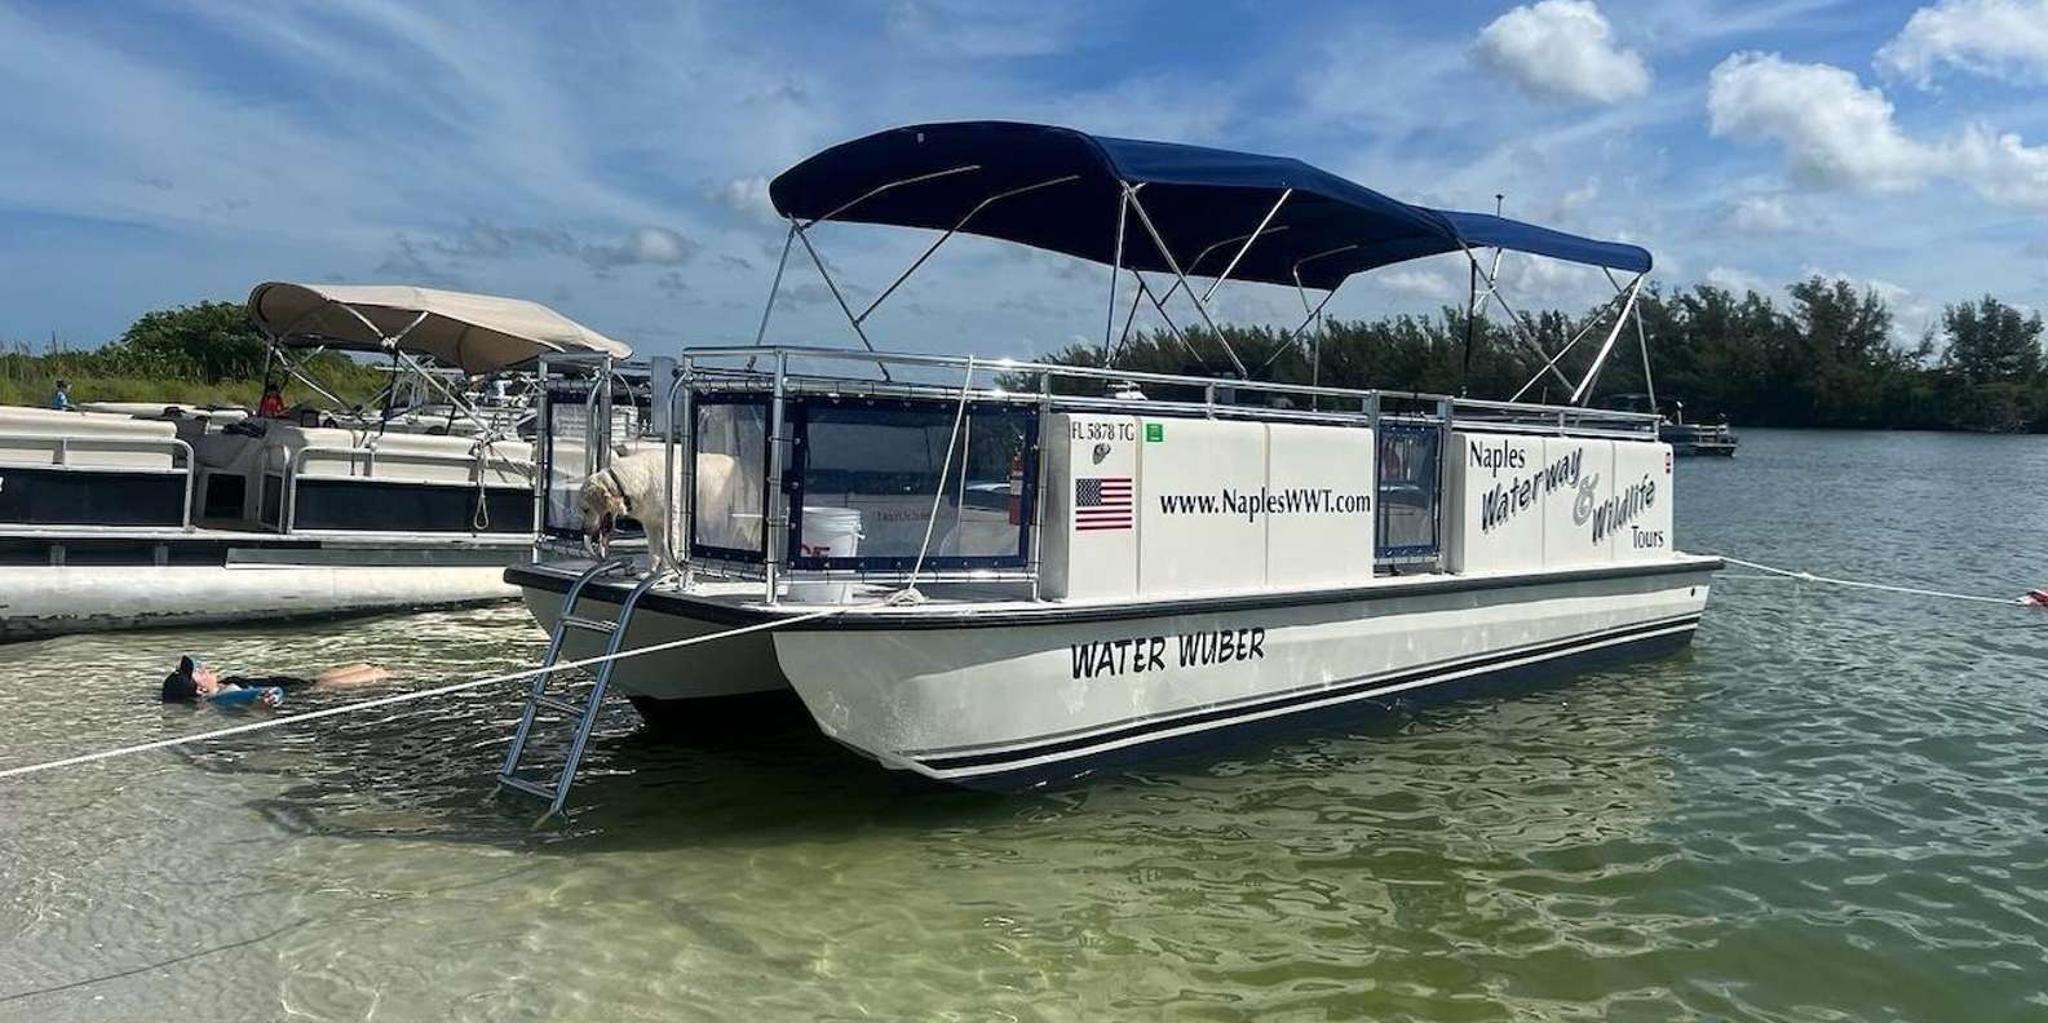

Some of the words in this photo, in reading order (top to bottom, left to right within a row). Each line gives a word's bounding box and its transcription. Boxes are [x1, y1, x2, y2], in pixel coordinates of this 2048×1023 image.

[1072, 421, 1084, 439] FL
[1087, 422, 1115, 441] 5878
[1118, 423, 1135, 441] TG
[1469, 440, 1526, 478] Naples
[1160, 486, 1372, 523] www.NaplesWWT.com
[1482, 447, 1584, 532] Waterway
[1573, 473, 1600, 527] &
[1592, 473, 1656, 545] Wildlife
[1631, 525, 1664, 549] Tours
[1071, 636, 1166, 679] WATER
[1178, 627, 1266, 668] WUBER
